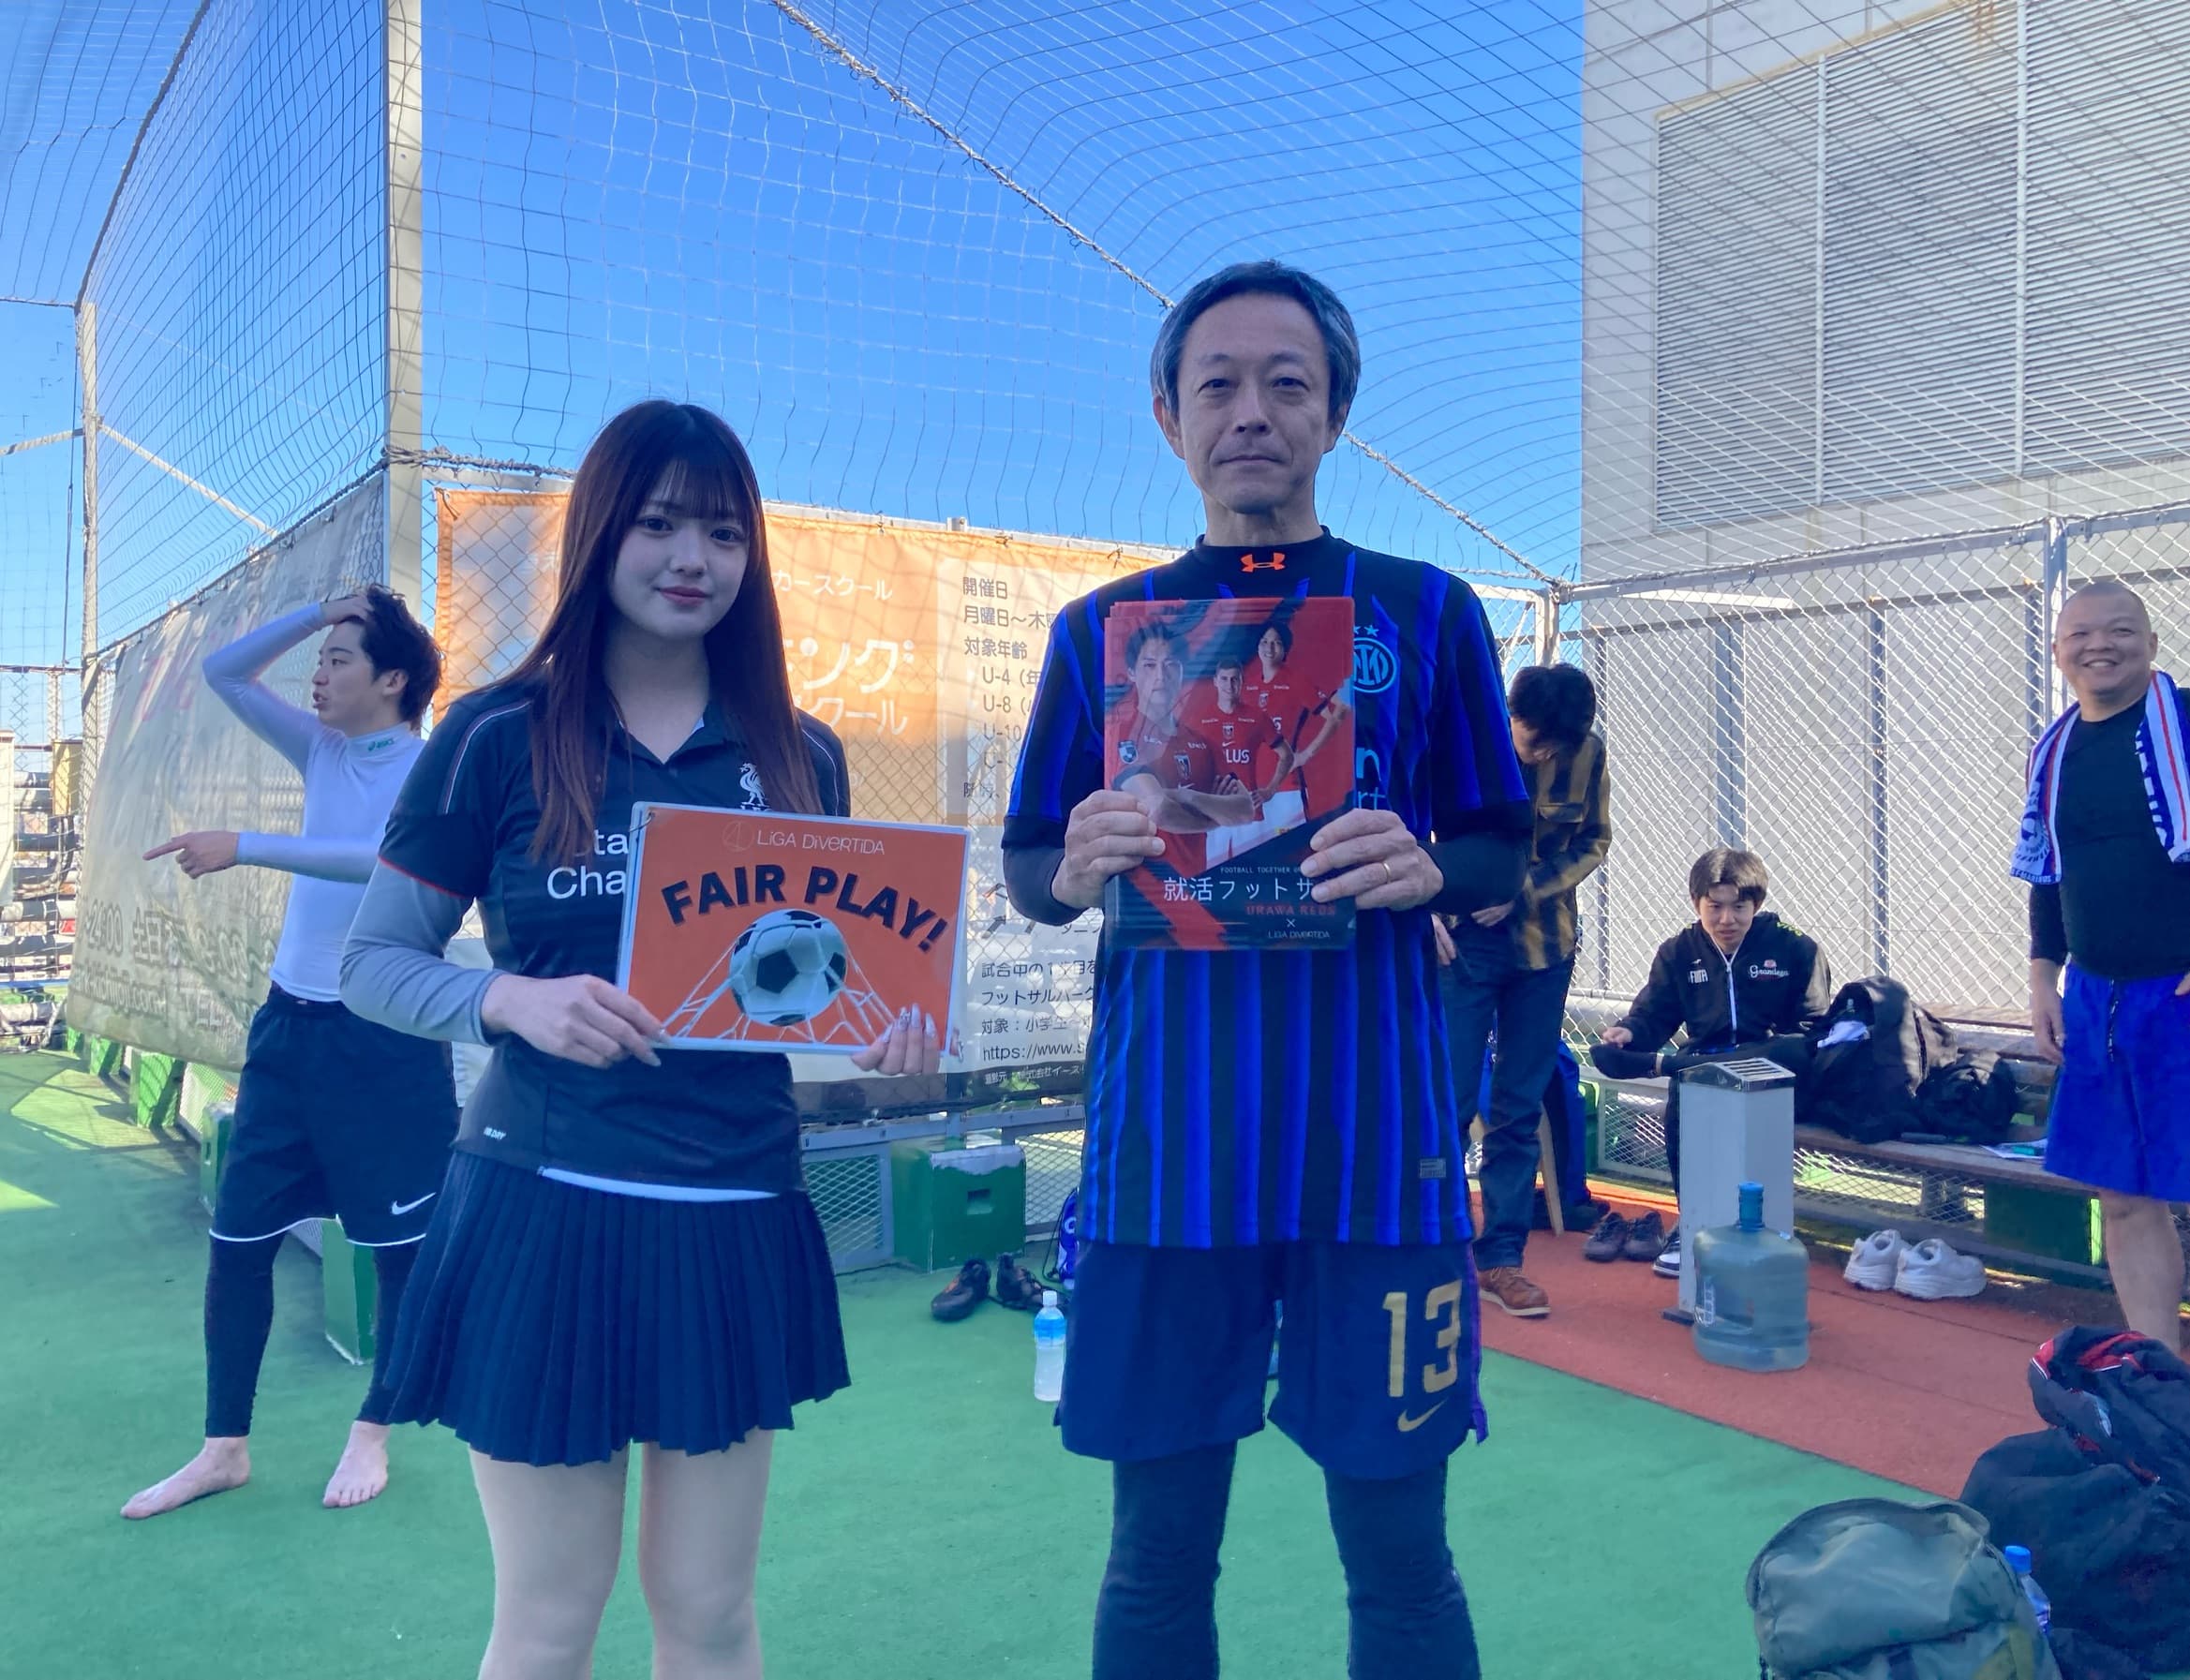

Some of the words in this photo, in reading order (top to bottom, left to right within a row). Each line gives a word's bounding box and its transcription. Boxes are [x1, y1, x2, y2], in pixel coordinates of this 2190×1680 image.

[962, 577, 1008, 601] 開催日
[963, 605, 1056, 631] 月曜日〜木
[784, 637, 915, 694] ング
[963, 636, 1028, 661] 対象年齢
[794, 695, 908, 736] クール
[547, 865, 627, 899] Cha
[661, 864, 787, 926] FAIR
[804, 866, 948, 953] PLAY!
[1382, 1279, 1463, 1398] 13
